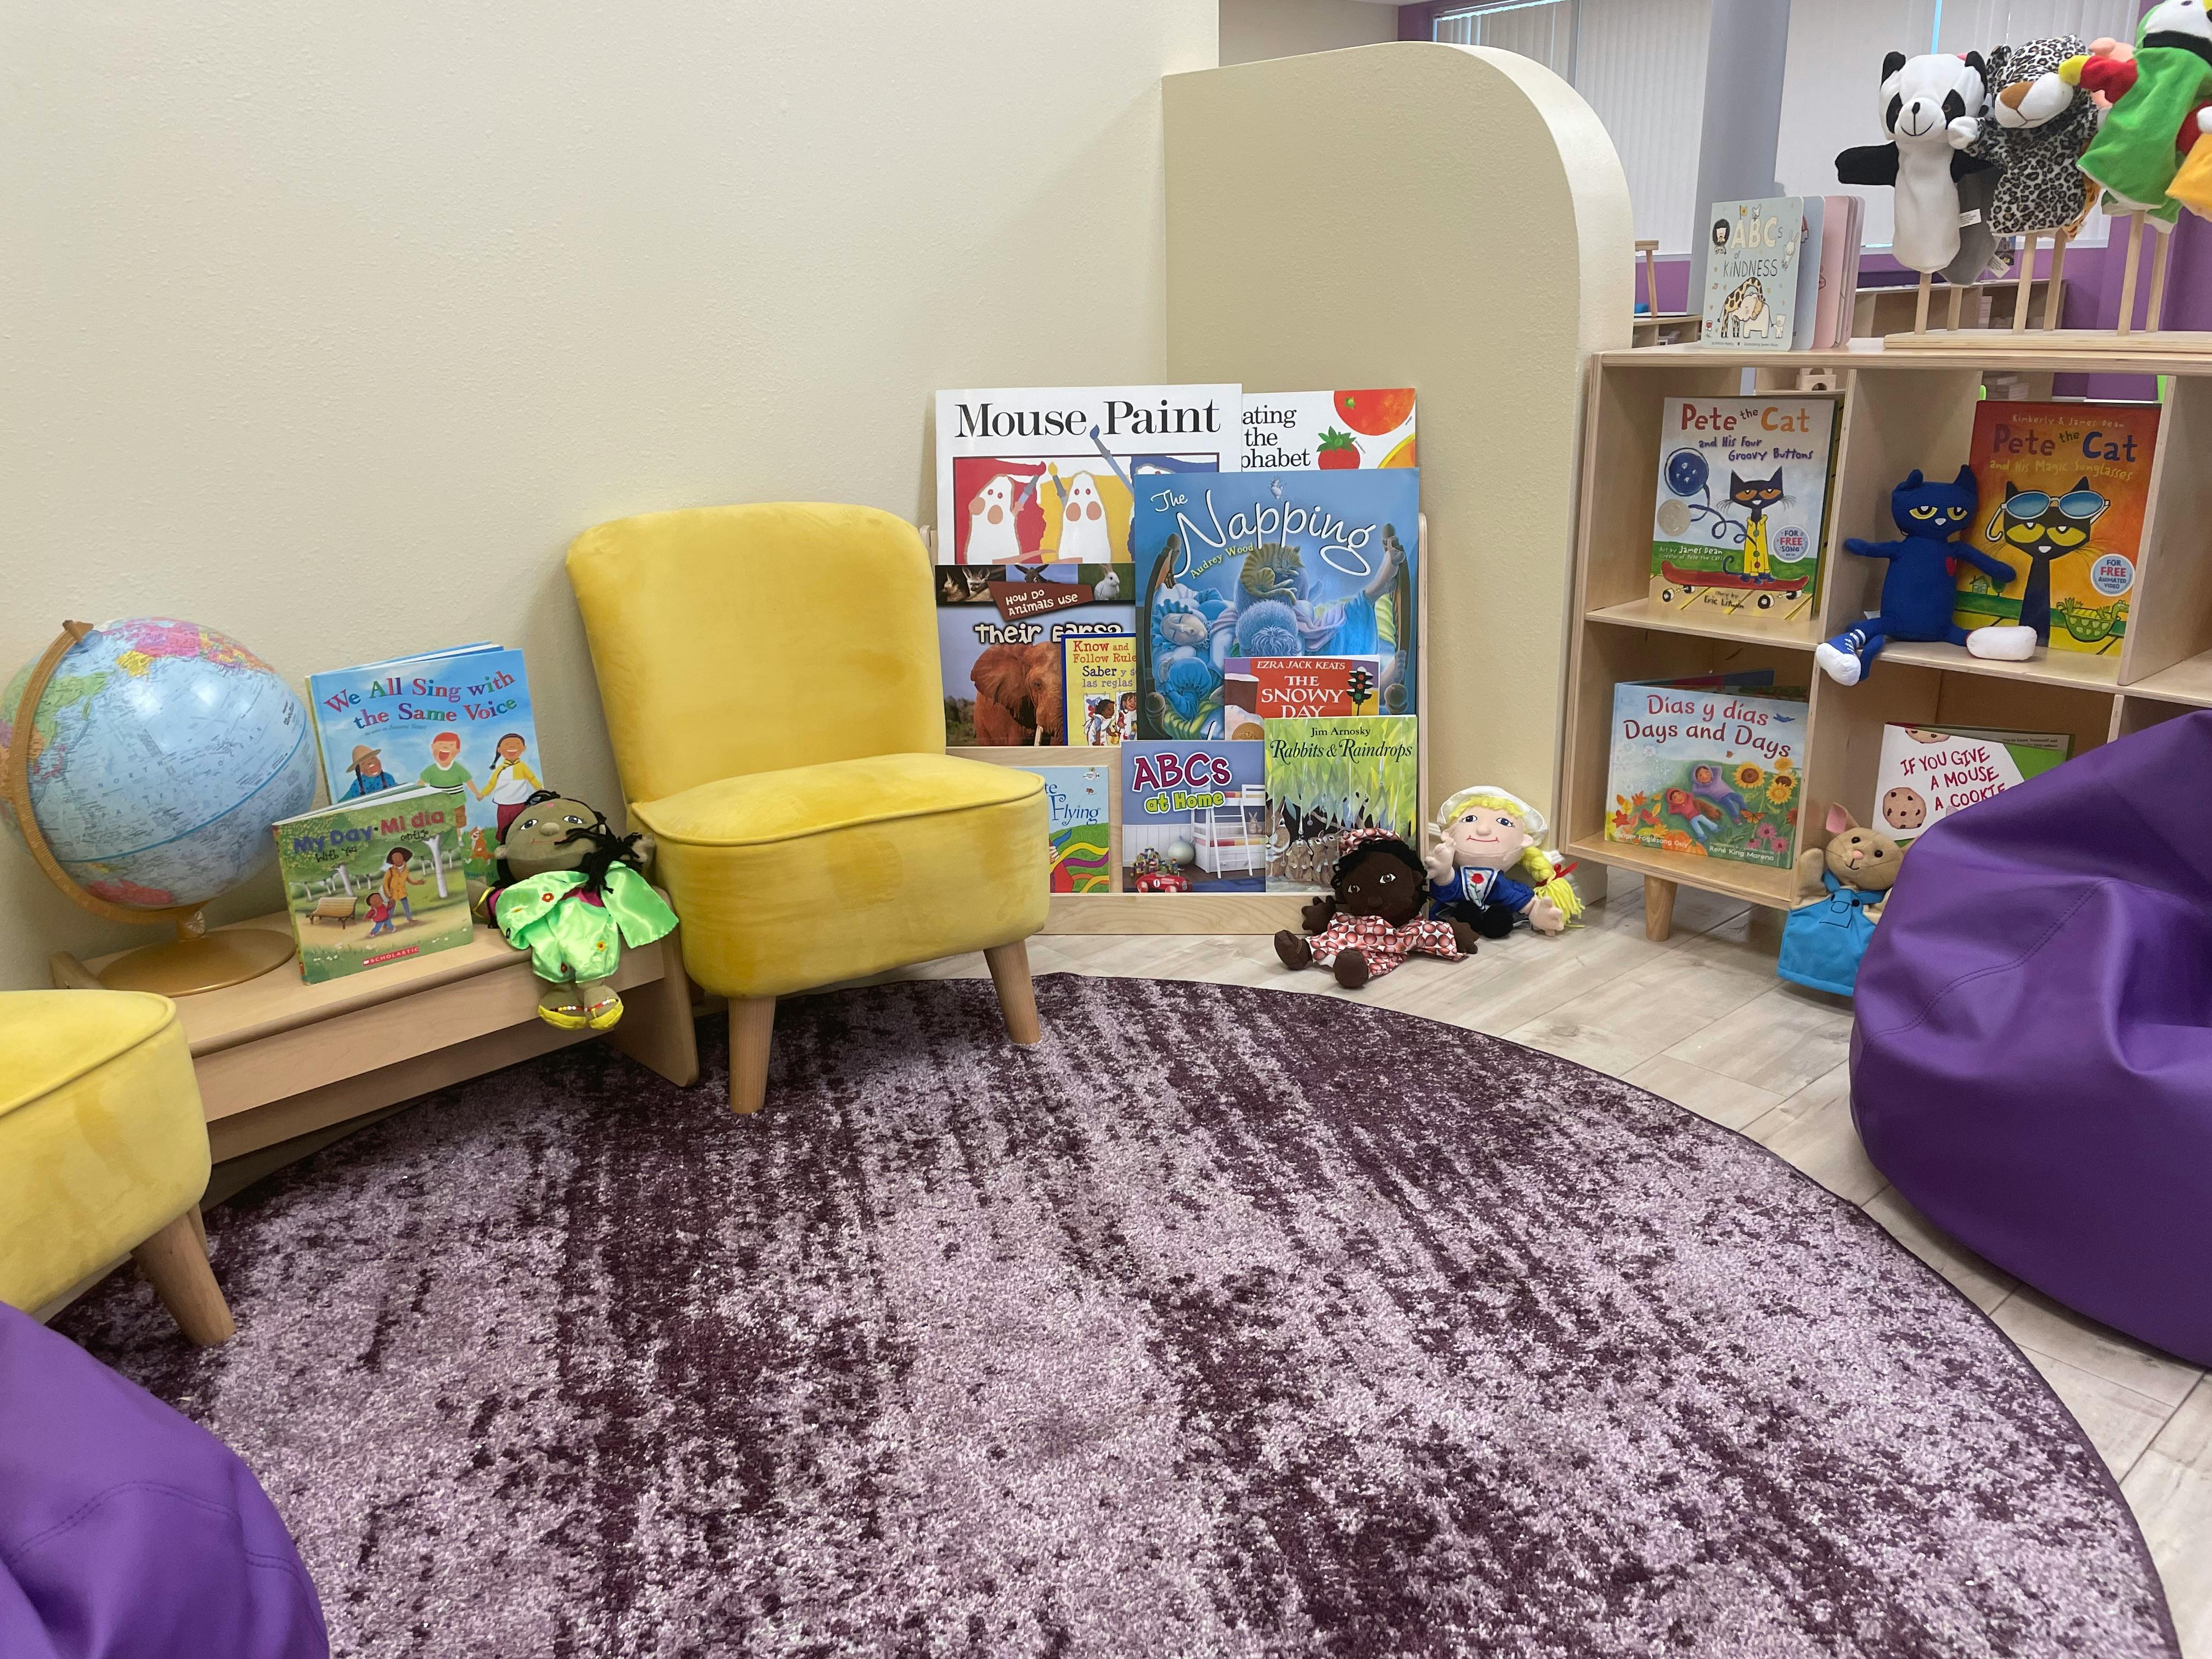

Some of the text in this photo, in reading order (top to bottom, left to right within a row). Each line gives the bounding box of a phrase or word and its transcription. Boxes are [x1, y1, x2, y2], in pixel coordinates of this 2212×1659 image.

[1734, 250, 1741, 259] of
[955, 399, 1221, 438] Mouse Paint
[1681, 403, 1810, 433] Pete the Cat
[2012, 414, 2125, 428] Kimberly & James Dean
[1244, 427, 1278, 447] the
[1699, 435, 1762, 448] and His Four
[1993, 423, 2138, 462] Pete the Cat
[1729, 448, 1814, 462] Groovy Buttons
[1990, 460, 2133, 481] and His Magic Sunglasses
[1150, 489, 1376, 578] The Napping
[1780, 537, 1803, 545] FREE
[1679, 545, 1702, 554] James
[1190, 543, 1254, 580] Audrey Wood
[2101, 566, 2126, 577] FREE
[1704, 595, 1718, 605] Eric
[975, 623, 1042, 645] Their
[1073, 640, 1109, 652] Know
[1073, 653, 1109, 663] Follow
[1288, 661, 1311, 670] JACK
[1315, 662, 1346, 670] KEATS
[1082, 665, 1117, 676] Saber
[1082, 678, 1133, 689] las reglas
[1284, 675, 1320, 686] THE
[324, 670, 515, 712] We All Sing with
[1261, 688, 1345, 703] SNOWY
[354, 699, 517, 729] the Same Voice
[1281, 705, 1325, 718] DAY
[1646, 694, 1769, 726] Días y días
[1310, 727, 1371, 737] Jim Arnosky
[1623, 720, 1791, 759] Days and Days
[1270, 738, 1413, 765] Rabbits & Raindrops
[1900, 746, 1991, 776] IF YOU GIVE
[1132, 752, 1232, 792] ABCs
[1931, 766, 2000, 791] A MOUSE
[1048, 794, 1101, 826] Flying
[1145, 792, 1225, 812] at Home
[1935, 797, 1944, 811] A
[294, 836, 325, 854] My
[330, 825, 373, 845] Day
[381, 816, 406, 836] Mi
[1639, 835, 1672, 845] Foglesong
[1674, 840, 1689, 849] Guy
[341, 846, 357, 856] You
[1709, 846, 1727, 854] René
[1729, 849, 1745, 857] King
[1747, 851, 1774, 862] Moreno
[370, 947, 419, 963] SCHOLASTIC
